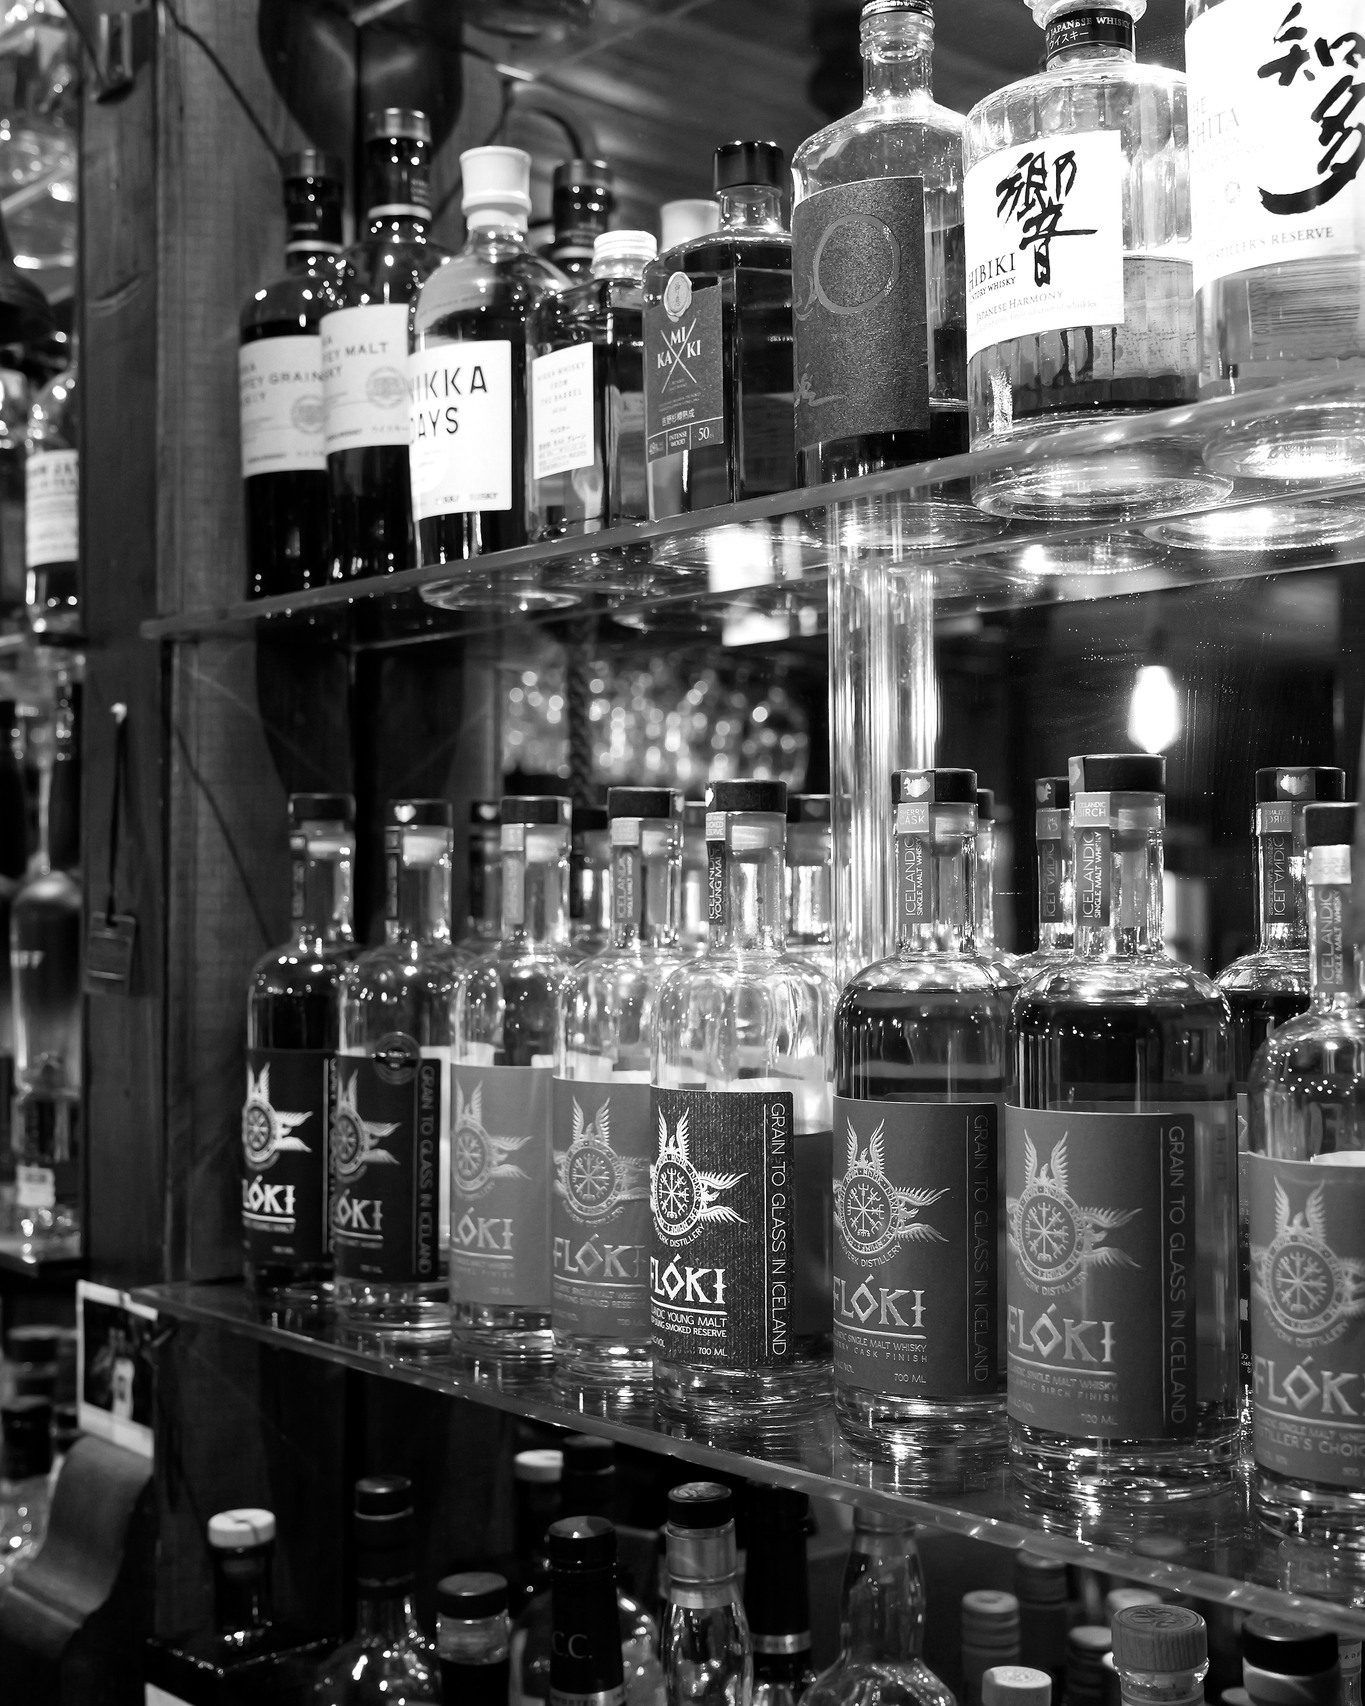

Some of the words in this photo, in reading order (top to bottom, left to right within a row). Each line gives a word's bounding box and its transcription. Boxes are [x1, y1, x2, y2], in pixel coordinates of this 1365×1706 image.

[1049, 30, 1089, 49] ウイスキー
[1050, 17, 1093, 40] JAPANESE
[996, 151, 1098, 287] 響
[1271, 226, 1336, 246] RESERVE
[968, 253, 1016, 292] HIBIKI
[987, 276, 1016, 292] WHISKY
[1009, 289, 1063, 310] HARMONY
[344, 342, 388, 356] MALT
[1094, 831, 1102, 862] WHISKY
[904, 837, 917, 916] ICELANDIC
[1082, 831, 1095, 918] ICELANDIC
[1094, 866, 1102, 891] MALT
[916, 890, 924, 916] SINGLE
[1094, 892, 1102, 918] SINGLE
[1318, 890, 1334, 985] ICELANDIC
[771, 1102, 786, 1155] GRAIN
[974, 1113, 989, 1169] GRAIN
[1168, 1125, 1185, 1187] GRAIN
[771, 1161, 786, 1187] TO
[974, 1180, 988, 1203] TO
[771, 1193, 786, 1253] GLASS
[1168, 1195, 1185, 1225] TO
[669, 1223, 705, 1248] DISTILLERY
[974, 1210, 989, 1273] GLASS
[772, 1259, 786, 1274] IN
[860, 1241, 902, 1268] DISTILLERY
[1169, 1232, 1186, 1302] GLASS
[650, 1253, 727, 1305] FLÓKI
[974, 1280, 989, 1296] IN
[833, 1274, 927, 1328] FLÓKI
[666, 1322, 692, 1335] SMOKED
[693, 1327, 728, 1338] RESERVE
[667, 1311, 695, 1325] YOUNG
[697, 1316, 728, 1328] MALT
[772, 1281, 787, 1355] ICELAND
[1170, 1310, 1186, 1328] IN
[848, 1334, 868, 1347] SINGLE
[869, 1339, 891, 1350] MALT
[893, 1342, 927, 1353] WHISKY
[974, 1303, 989, 1382] ICELAND
[1007, 1303, 1116, 1363] FLÓKI
[698, 1347, 712, 1355] 700
[713, 1347, 728, 1357] ML
[854, 1347, 878, 1358] CASK
[886, 1352, 928, 1363] FINISH
[894, 1373, 909, 1383] 700
[911, 1374, 927, 1384] ML
[1053, 1376, 1077, 1388] MALT
[1079, 1380, 1119, 1391] WHISKY
[1170, 1336, 1187, 1424] ICELAND
[1254, 1355, 1365, 1416] FLÓK
[1078, 1391, 1119, 1402] FINISH
